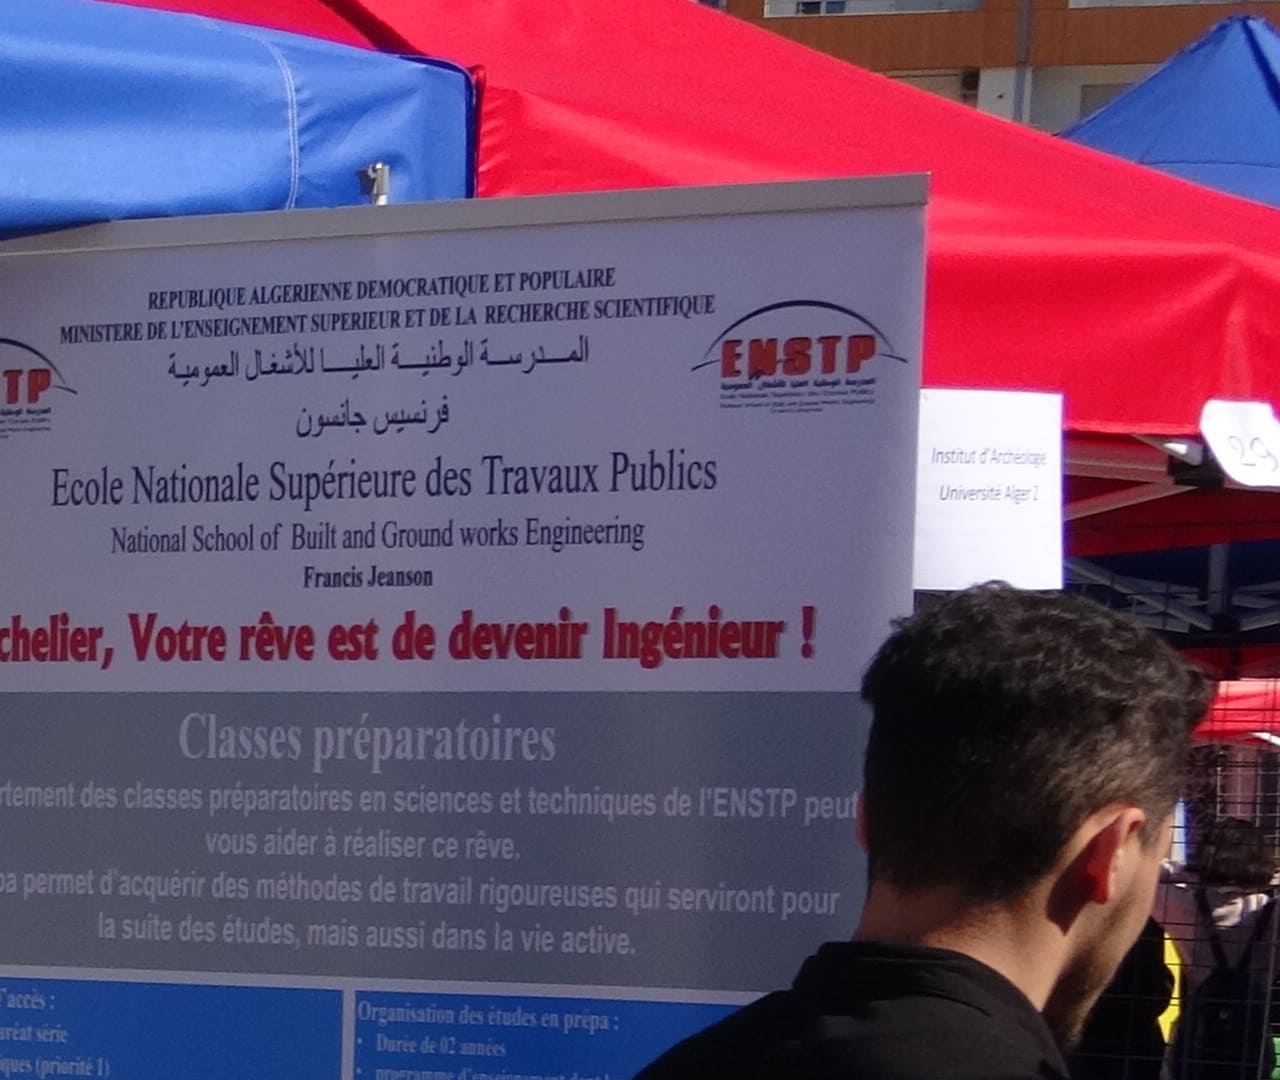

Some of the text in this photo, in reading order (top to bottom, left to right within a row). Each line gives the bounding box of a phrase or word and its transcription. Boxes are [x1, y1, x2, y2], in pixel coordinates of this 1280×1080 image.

[148, 268, 615, 311] REPUBLIQUE ALGERIENNE DEMOCRATIQUE ET POPULAIRE
[61, 323, 143, 344] MINISTERE
[148, 323, 167, 340] DE
[311, 311, 400, 334] SUPERIEUR
[406, 309, 425, 327] ET
[430, 308, 453, 326] DE
[456, 308, 477, 325] LA
[485, 300, 590, 324] RECHERCHE
[594, 294, 715, 319] SCIENTIFIQUE
[721, 335, 877, 377] ENSTP
[931, 447, 976, 464] Institut
[52, 448, 717, 511] Ecole Nationale Supérieure des Travaux Publics
[939, 484, 1001, 502] Université
[1004, 485, 1031, 504] Alger
[111, 516, 645, 554] National School of Built and Ground works Engineering
[304, 565, 433, 588] Francis Jeanson
[129, 613, 227, 661] Votre
[240, 611, 314, 661] rêve
[328, 618, 379, 660] est
[392, 610, 435, 660] de
[448, 606, 588, 659] devenir
[603, 605, 786, 669] Ingénieur
[801, 606, 815, 658] !
[179, 711, 556, 773] Classes préparatoires
